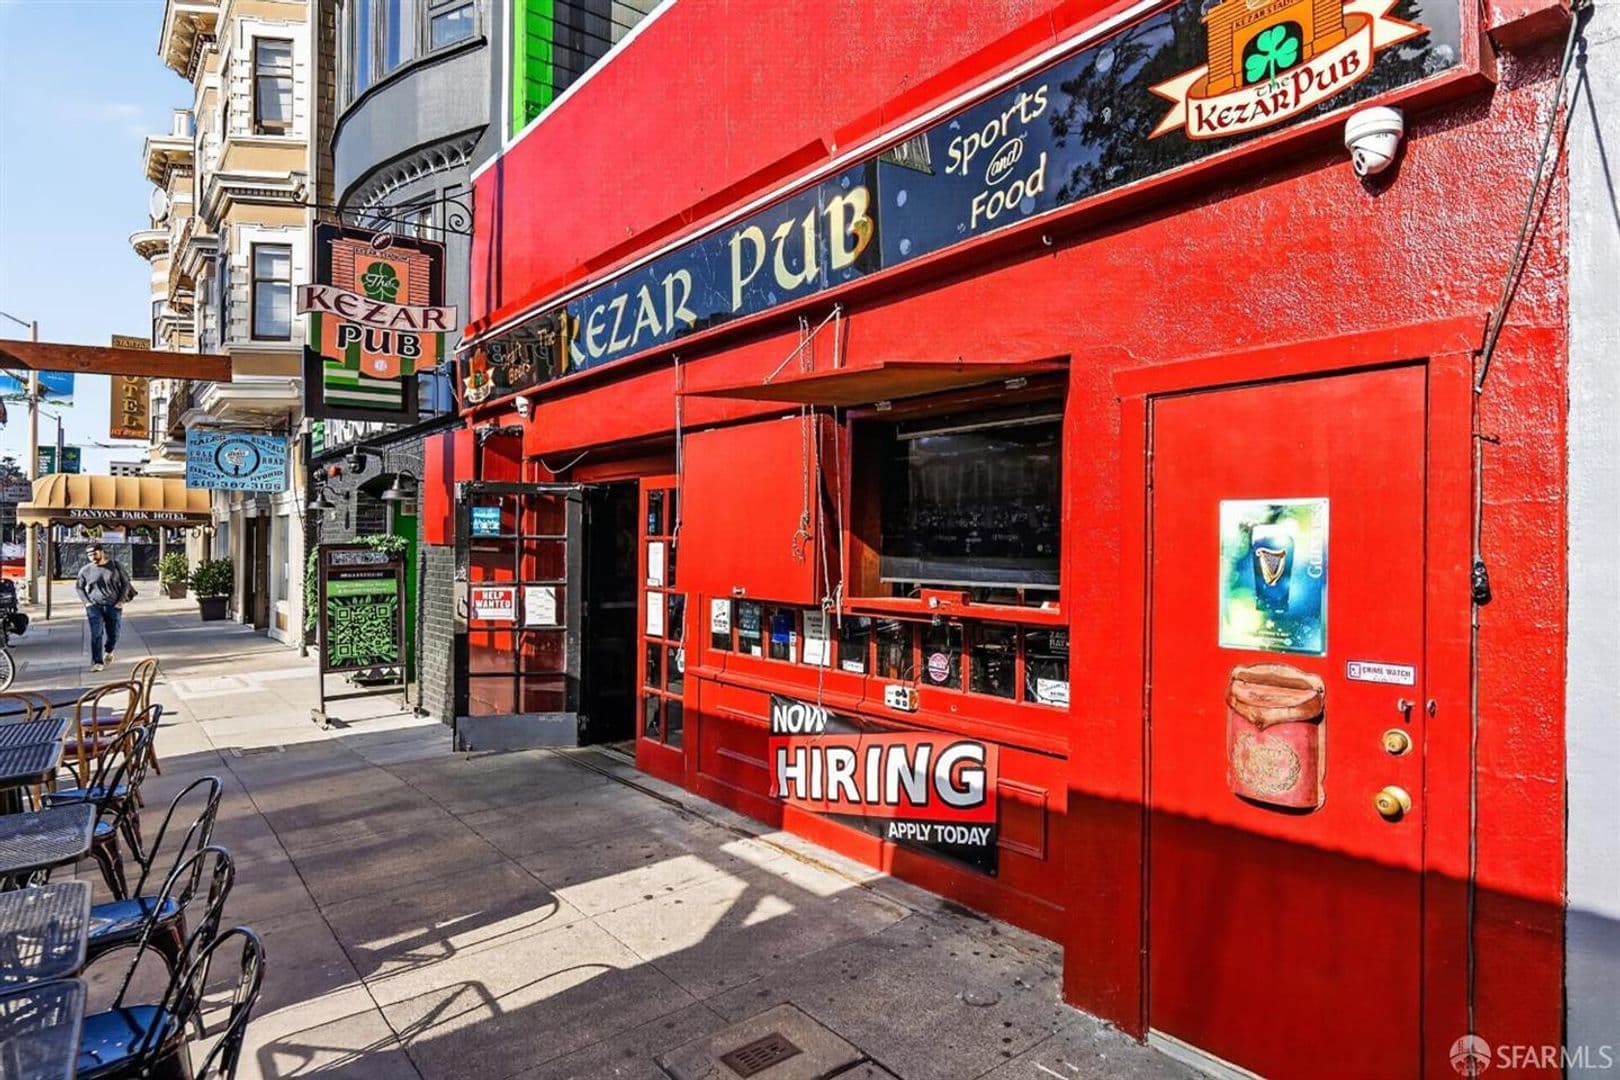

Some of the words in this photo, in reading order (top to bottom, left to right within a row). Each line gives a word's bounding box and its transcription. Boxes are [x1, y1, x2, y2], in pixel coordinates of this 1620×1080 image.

[1194, 90, 1291, 132] KEZAR
[1289, 50, 1361, 109] PUB
[945, 84, 1048, 176] Sports
[990, 141, 1019, 177] and
[971, 152, 1047, 229] Food
[365, 273, 392, 288] The
[560, 269, 698, 374] KEZAR
[728, 186, 875, 312] PUB
[306, 287, 447, 330] KEZAR
[336, 323, 422, 358] PUB
[122, 376, 138, 427] OTEL
[70, 510, 117, 518] STANYAN
[122, 511, 149, 519] PARK
[153, 512, 187, 520] HOTEL
[475, 600, 511, 609] WANTED
[482, 590, 505, 600] HELP
[772, 703, 828, 734] NOW
[776, 740, 987, 807] HIRING
[887, 822, 935, 842] APPLY
[935, 823, 991, 846] TODAY
